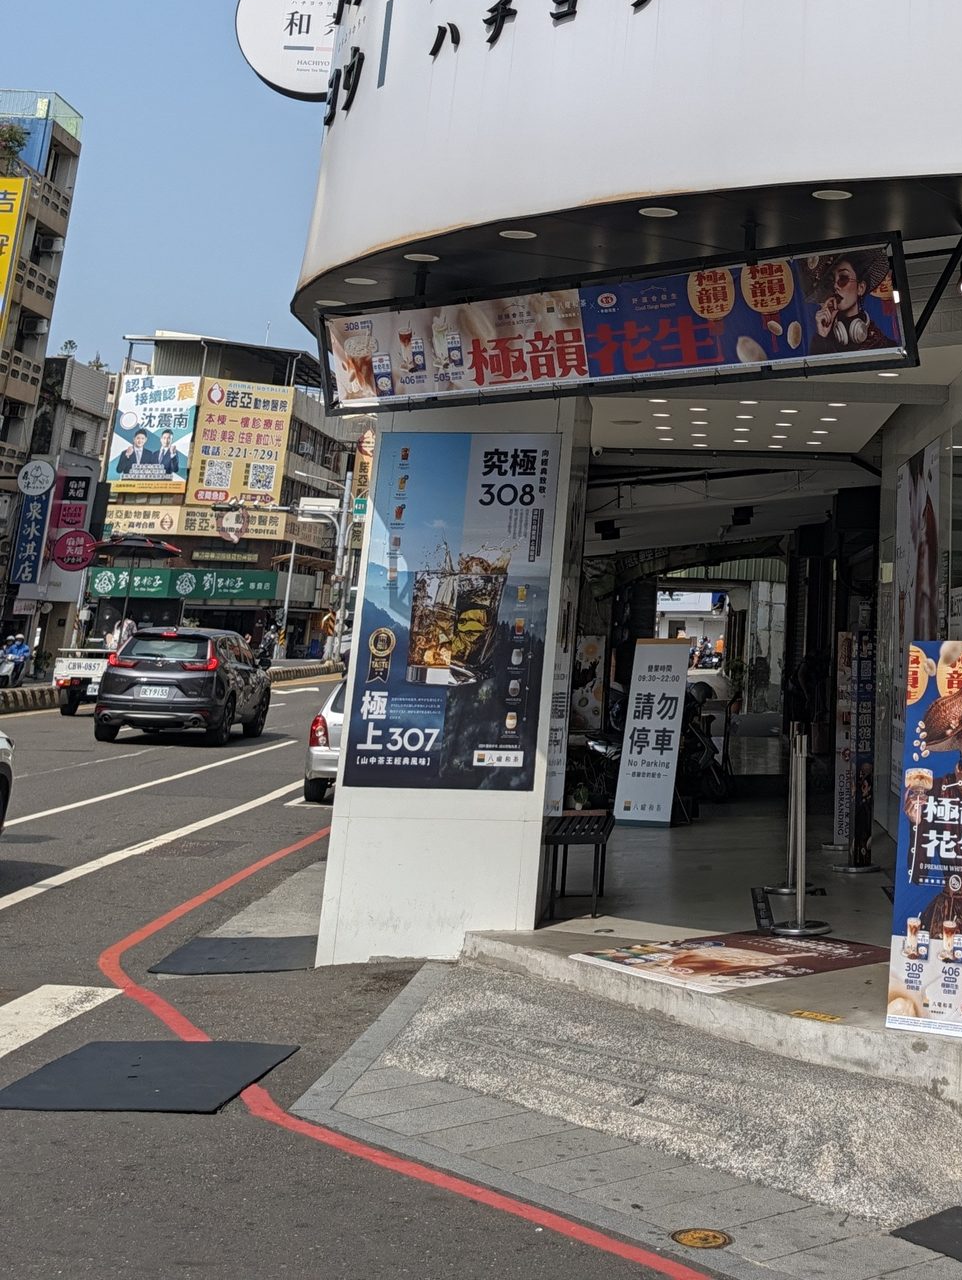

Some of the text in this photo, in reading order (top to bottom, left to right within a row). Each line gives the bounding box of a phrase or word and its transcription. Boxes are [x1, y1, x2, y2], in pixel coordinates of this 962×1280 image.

[297, 59, 330, 67] HACHIYO
[344, 322, 360, 332] 308
[125, 376, 155, 394] 認真
[400, 375, 416, 385] 406
[434, 372, 451, 383] 505
[225, 390, 288, 412] 諾亞動物醫院
[140, 412, 189, 429] 沈震南
[482, 448, 538, 477] 究極
[478, 483, 536, 507] 308
[185, 518, 210, 532] 諾亞
[360, 690, 389, 720] 極
[633, 692, 679, 721] 請勿
[629, 727, 675, 756] 停車
[628, 759, 671, 769] No Parking
[924, 863, 949, 871] PREMIUM
[905, 962, 924, 973] 308
[941, 966, 961, 977] 406
